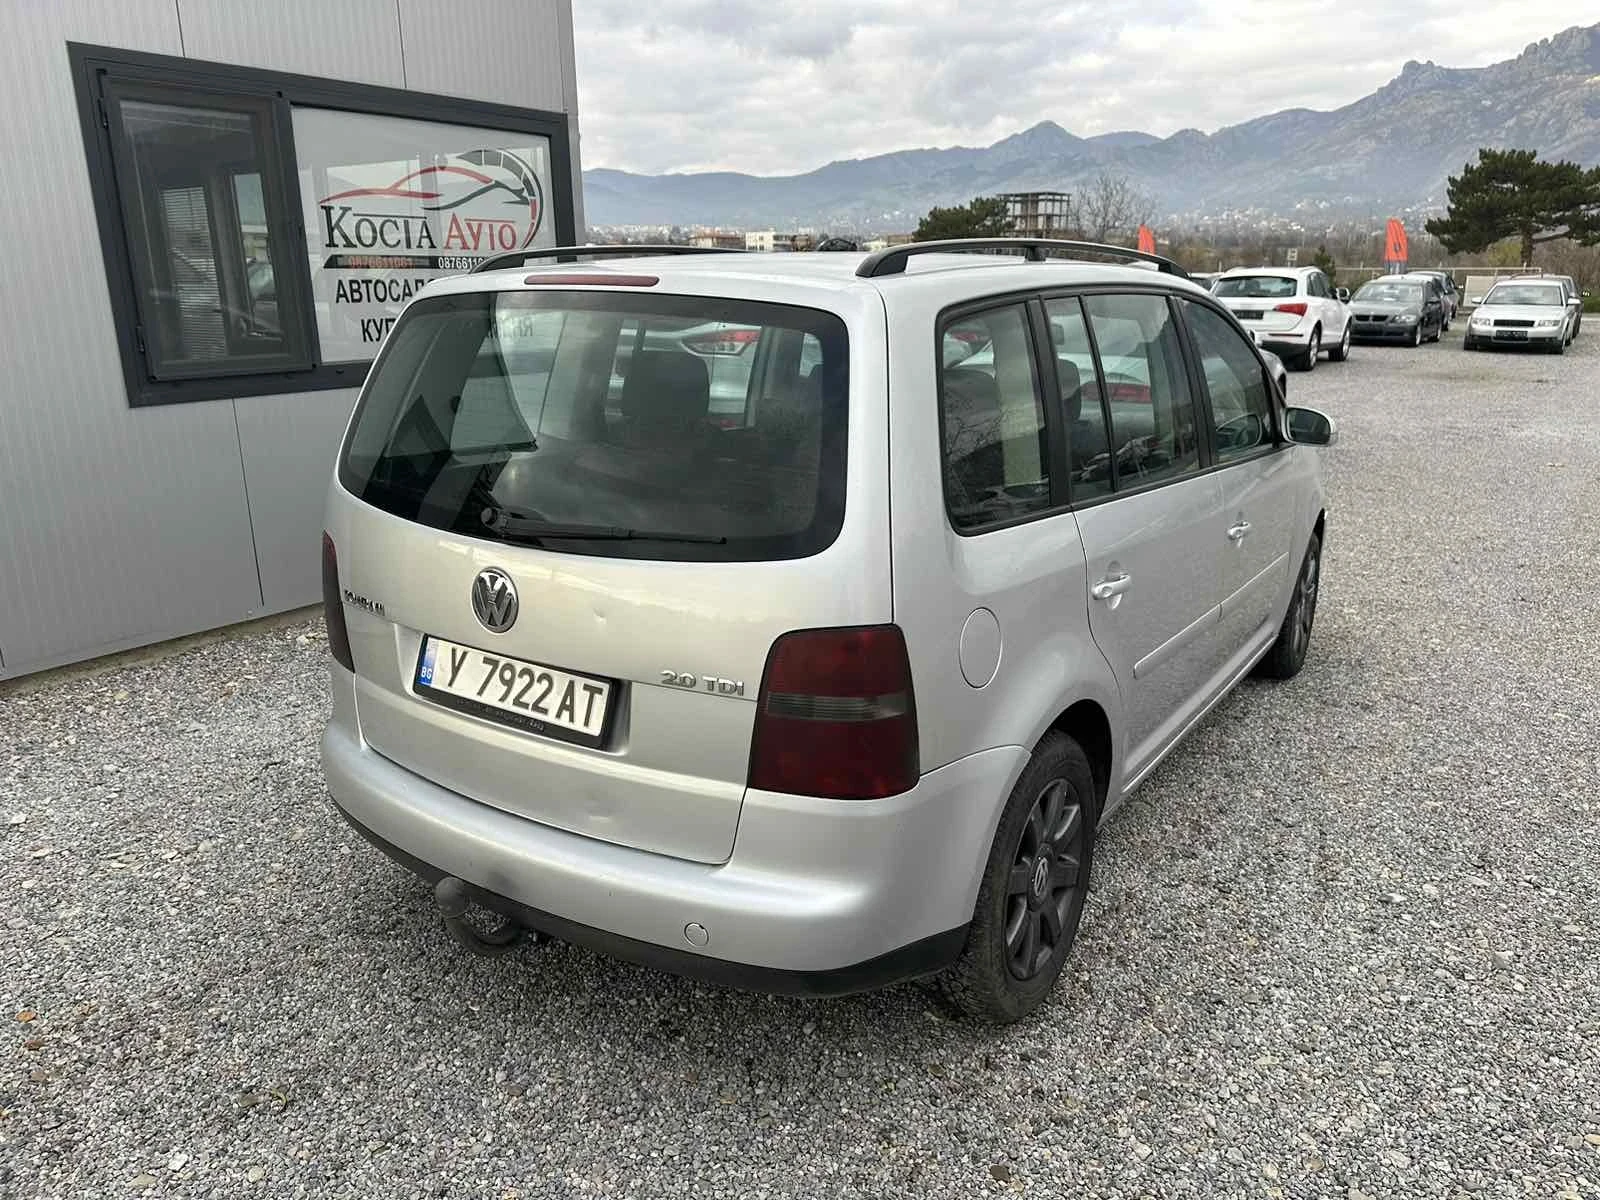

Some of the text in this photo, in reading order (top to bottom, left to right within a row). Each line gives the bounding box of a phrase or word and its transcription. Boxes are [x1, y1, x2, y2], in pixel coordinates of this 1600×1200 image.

[335, 279, 435, 304] АВТОСАЛ
[421, 666, 433, 680] BG
[702, 675, 745, 696] TDI
